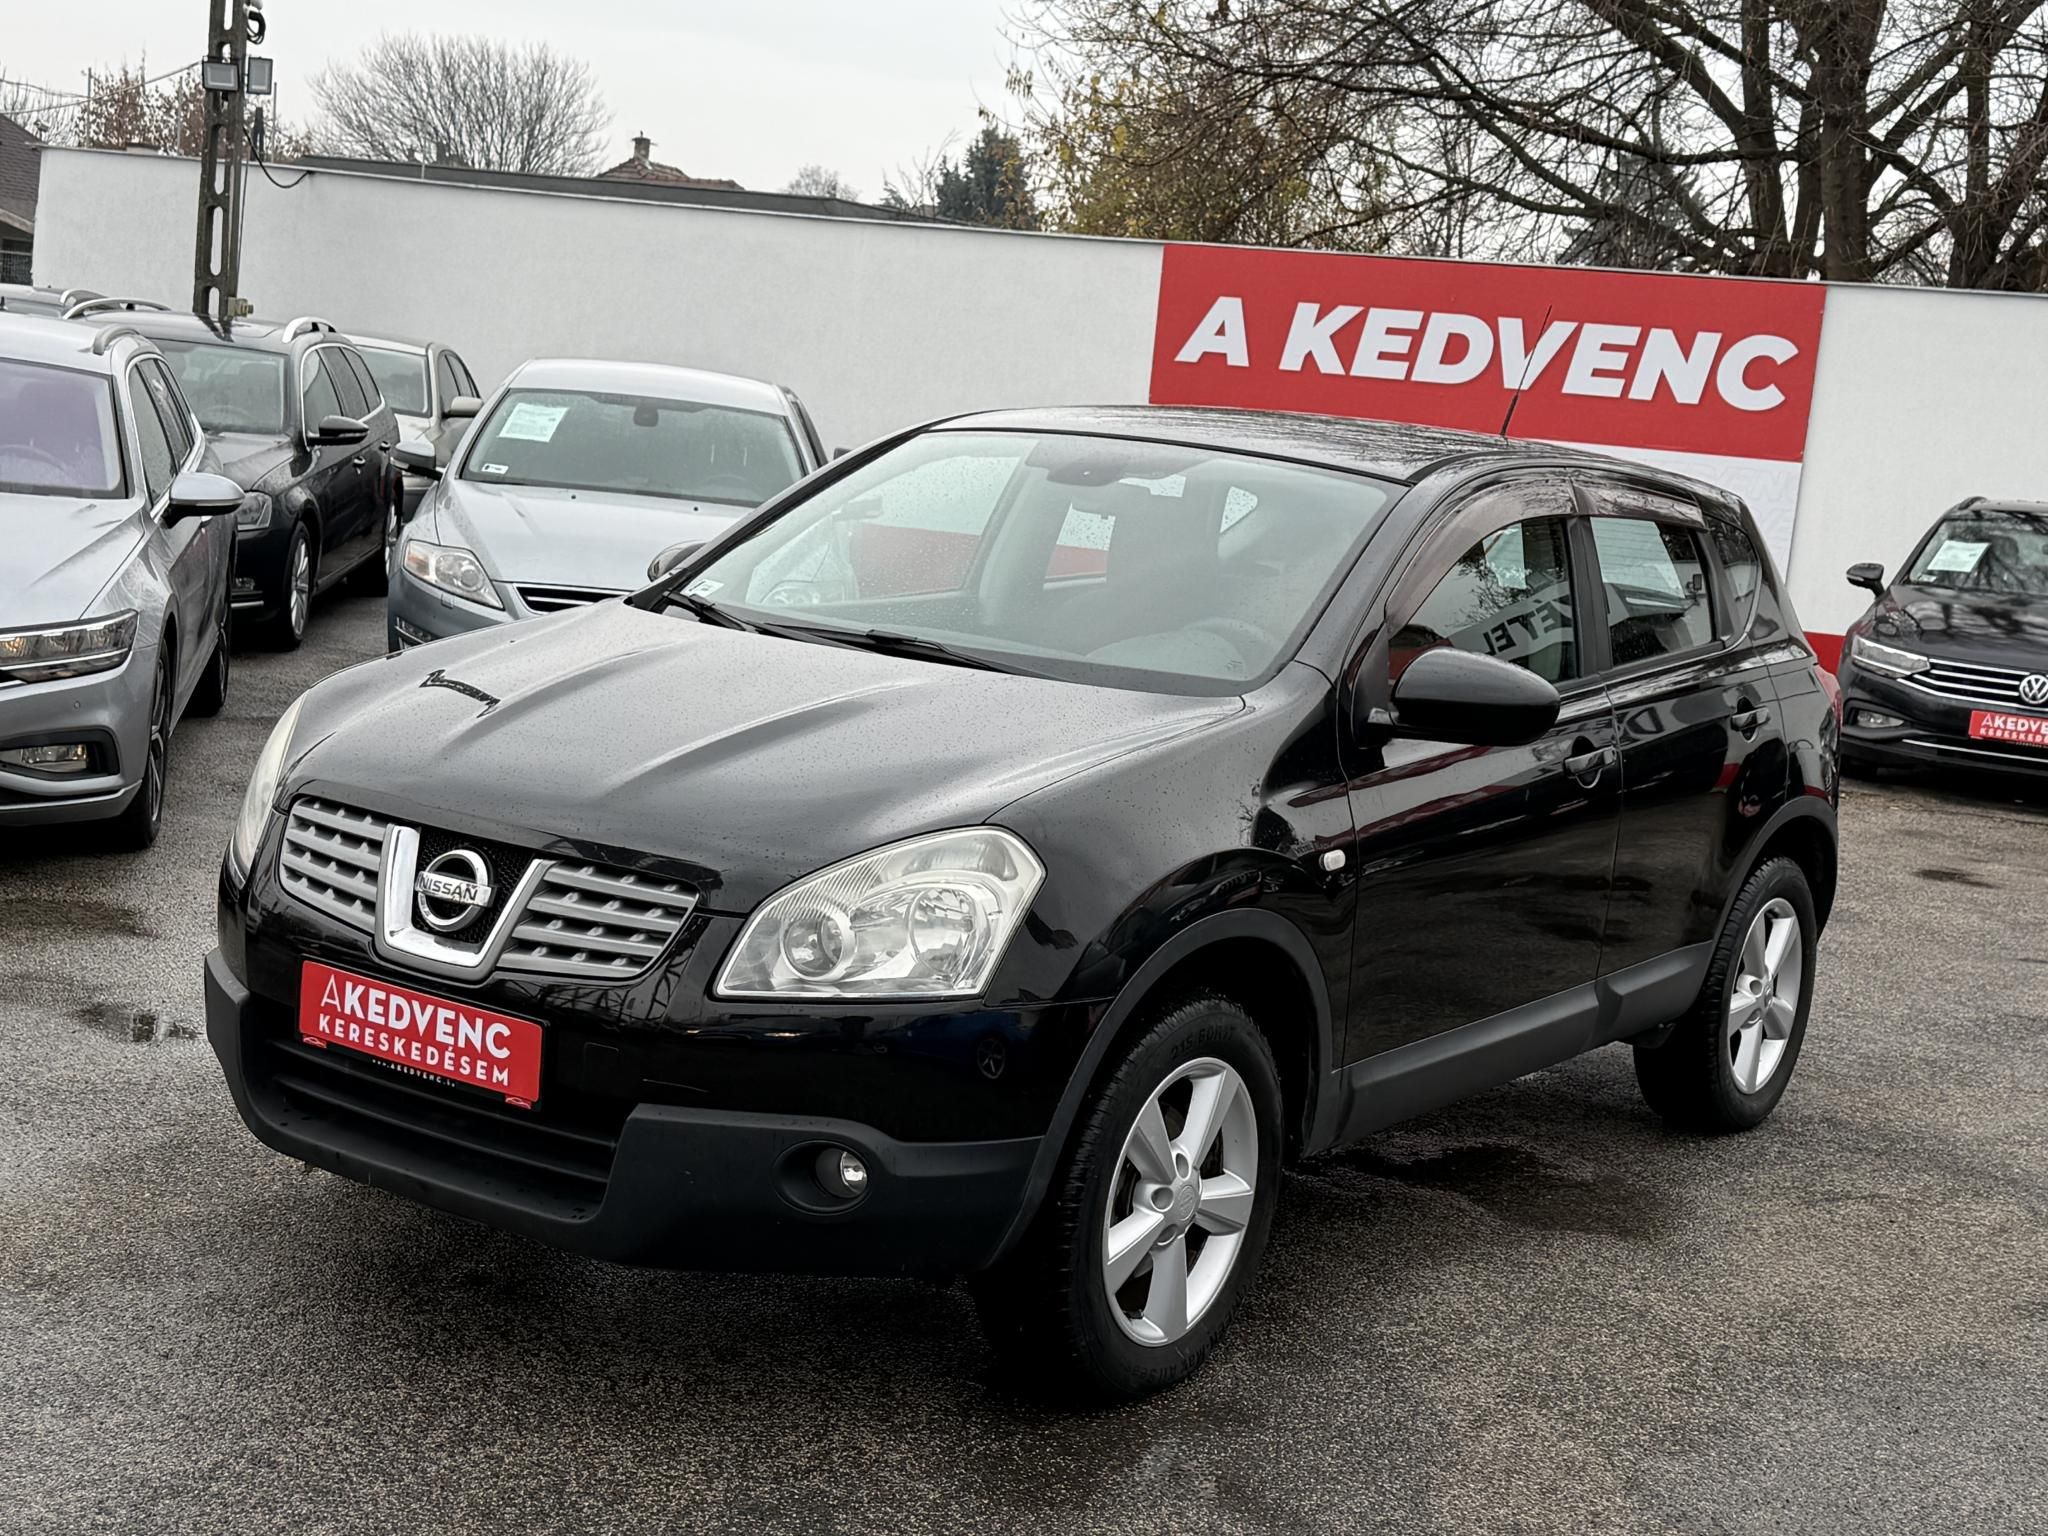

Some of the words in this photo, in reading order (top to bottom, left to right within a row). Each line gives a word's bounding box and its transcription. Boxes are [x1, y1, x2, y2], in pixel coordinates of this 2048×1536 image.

[1175, 295, 1250, 366] A
[1278, 302, 1799, 412] KEDVENC
[419, 874, 478, 901] NISSAN
[319, 1013, 510, 1087] KERESKEDÉSEM
